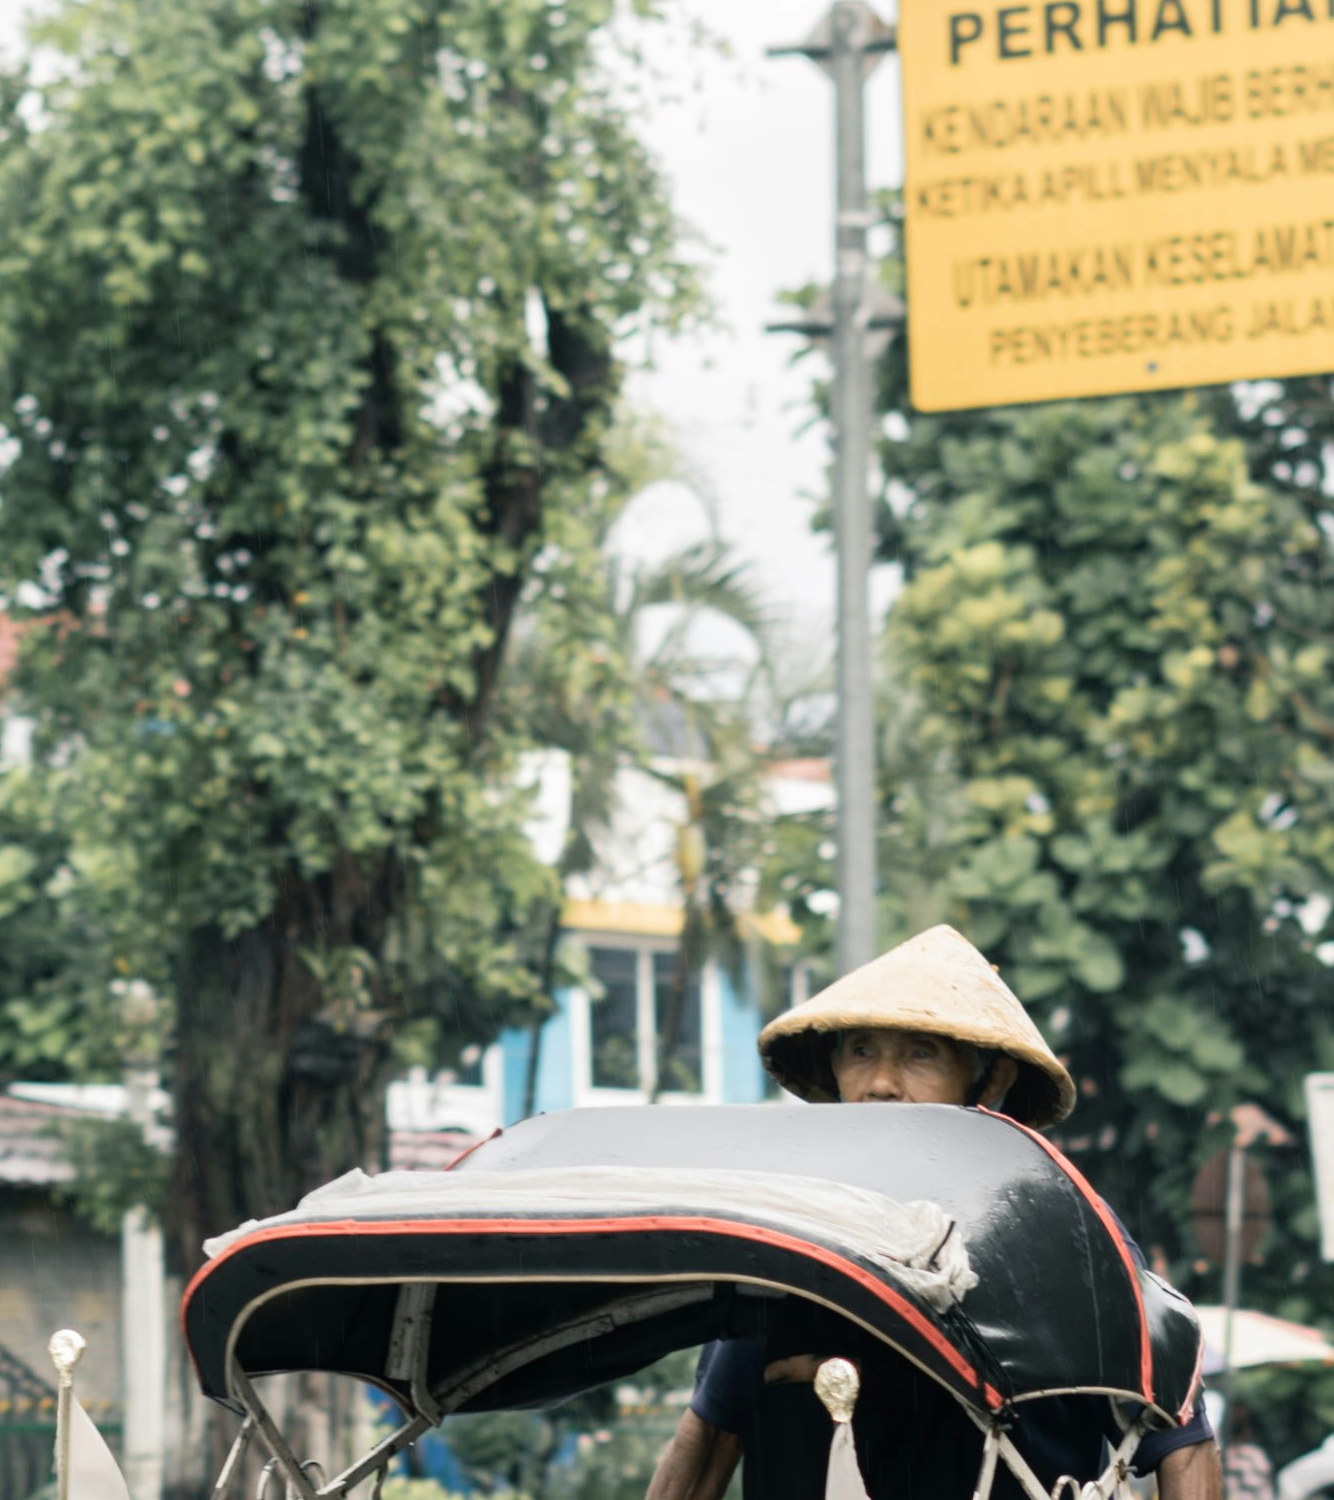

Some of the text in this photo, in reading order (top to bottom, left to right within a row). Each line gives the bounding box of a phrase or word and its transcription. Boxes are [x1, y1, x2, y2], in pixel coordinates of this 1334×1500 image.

[922, 88, 1127, 155] KENDARAAN
[1138, 74, 1233, 129] WAJIB
[917, 176, 1032, 218] KETIKA
[1137, 146, 1287, 195] MENYALA
[953, 251, 1133, 308] UTAMAKAN
[991, 307, 1233, 366] PENYEBERANG
